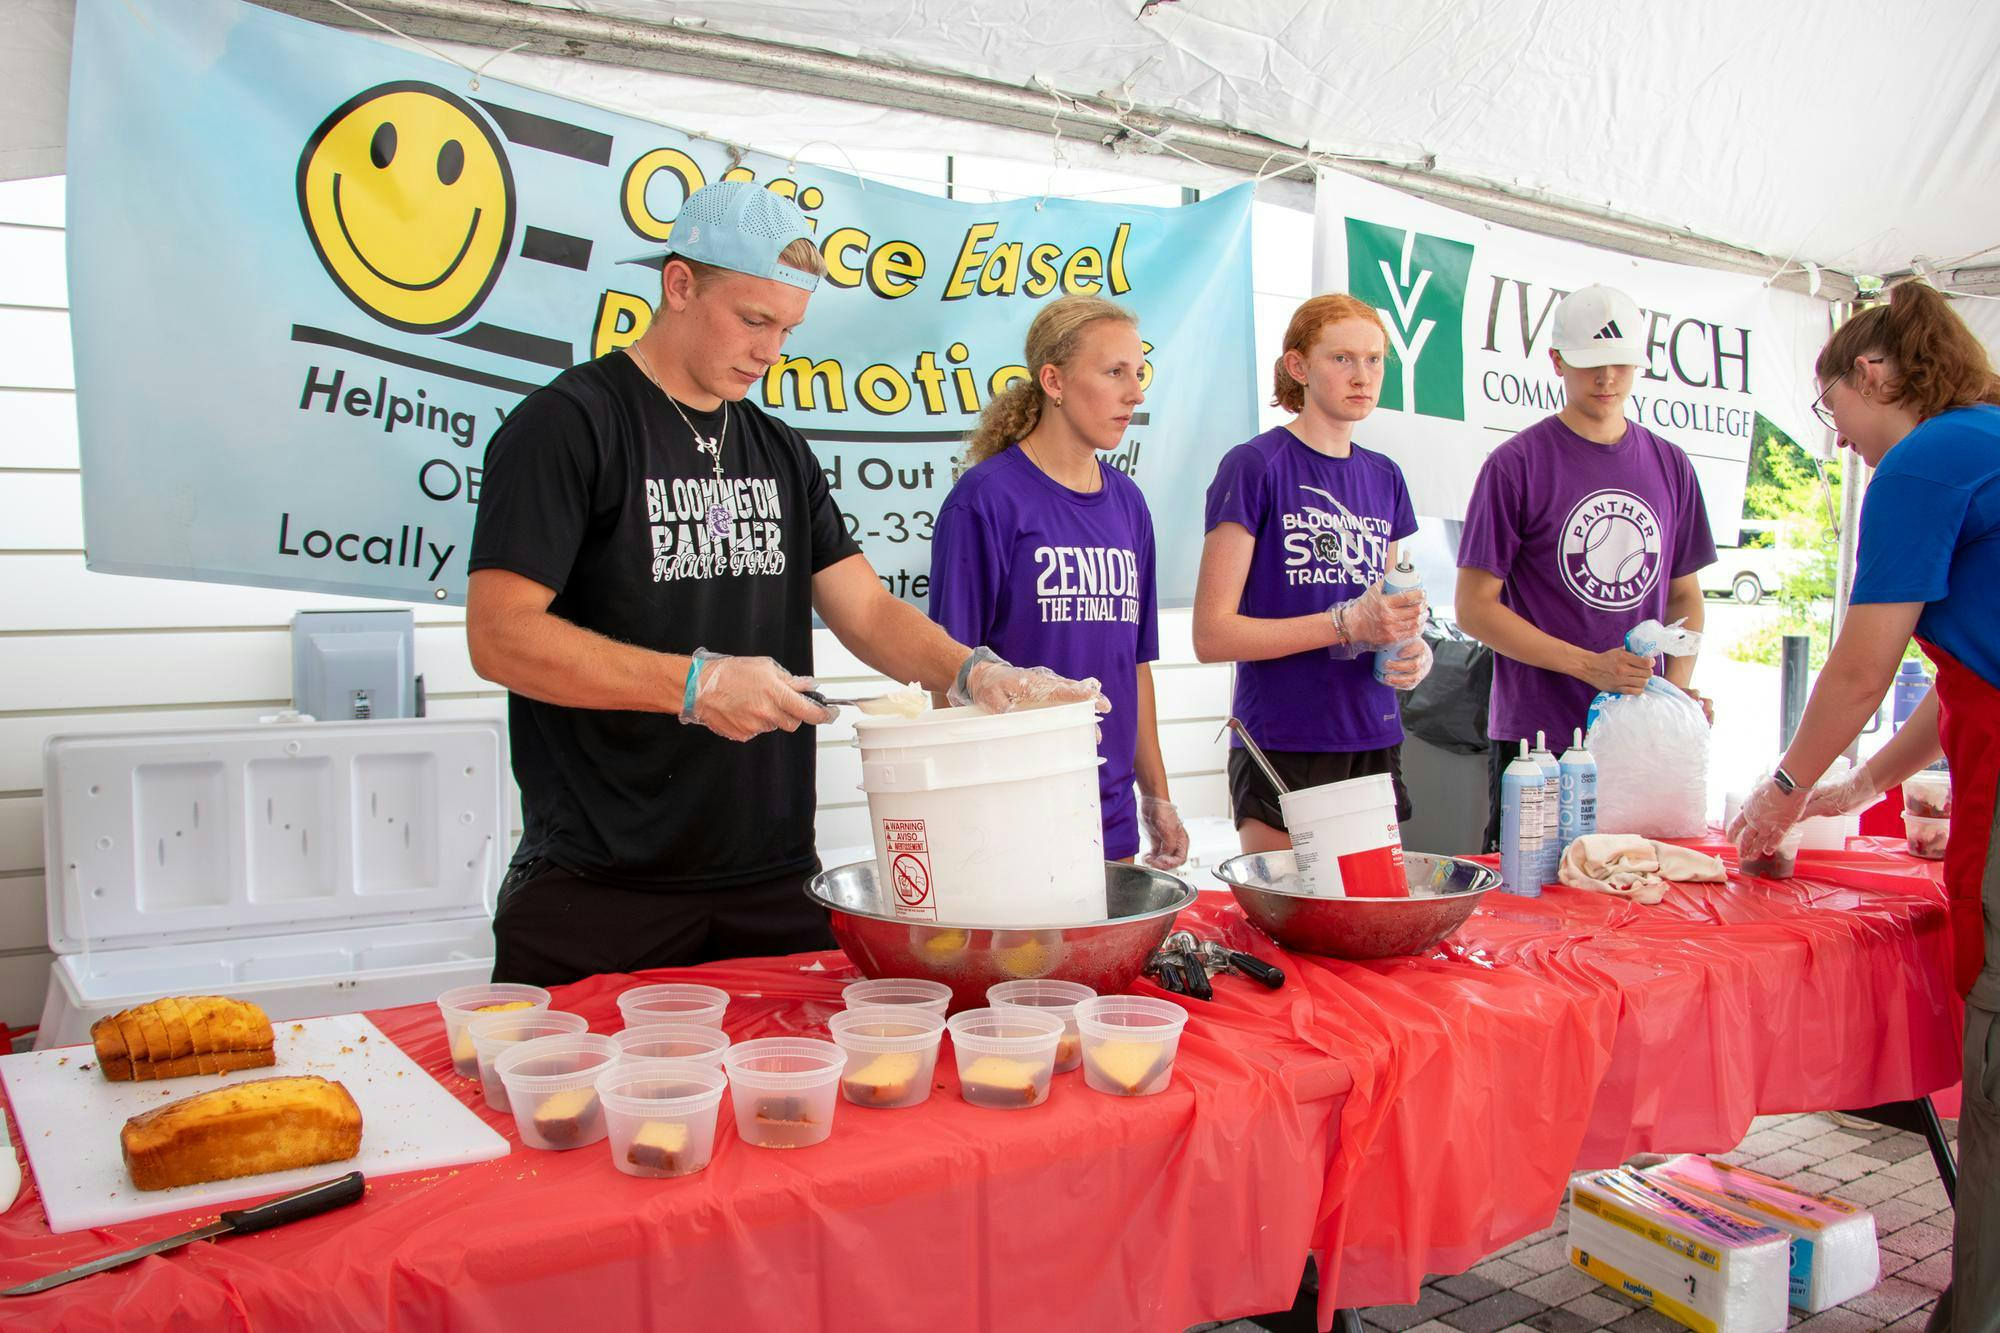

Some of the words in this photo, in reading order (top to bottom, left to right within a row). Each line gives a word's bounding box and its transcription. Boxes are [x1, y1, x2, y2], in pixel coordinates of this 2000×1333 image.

[620, 147, 926, 300] Oice
[941, 222, 1132, 301] Easel
[1481, 275, 1571, 359] IV
[1640, 308, 1752, 394] ECH
[1483, 371, 1647, 424] COMMY
[1653, 398, 1750, 438] COLLEGE
[299, 366, 476, 449] Helping
[857, 457, 934, 490] Out
[645, 478, 782, 522] BLOOMINGON
[1282, 513, 1392, 536] BLOOMINGTON
[1573, 501, 1654, 539] PANTHER
[278, 513, 456, 582] Locally
[715, 554, 728, 577] &
[1284, 532, 1388, 570] SUTH
[1286, 568, 1347, 586] TRACK
[1574, 563, 1650, 599] TENNIS
[1037, 597, 1072, 622] THE
[1076, 597, 1117, 622] FINAL
[890, 822, 923, 831] WARNING
[897, 832, 918, 841] AVISO
[1623, 1280, 1653, 1298] Napkins
